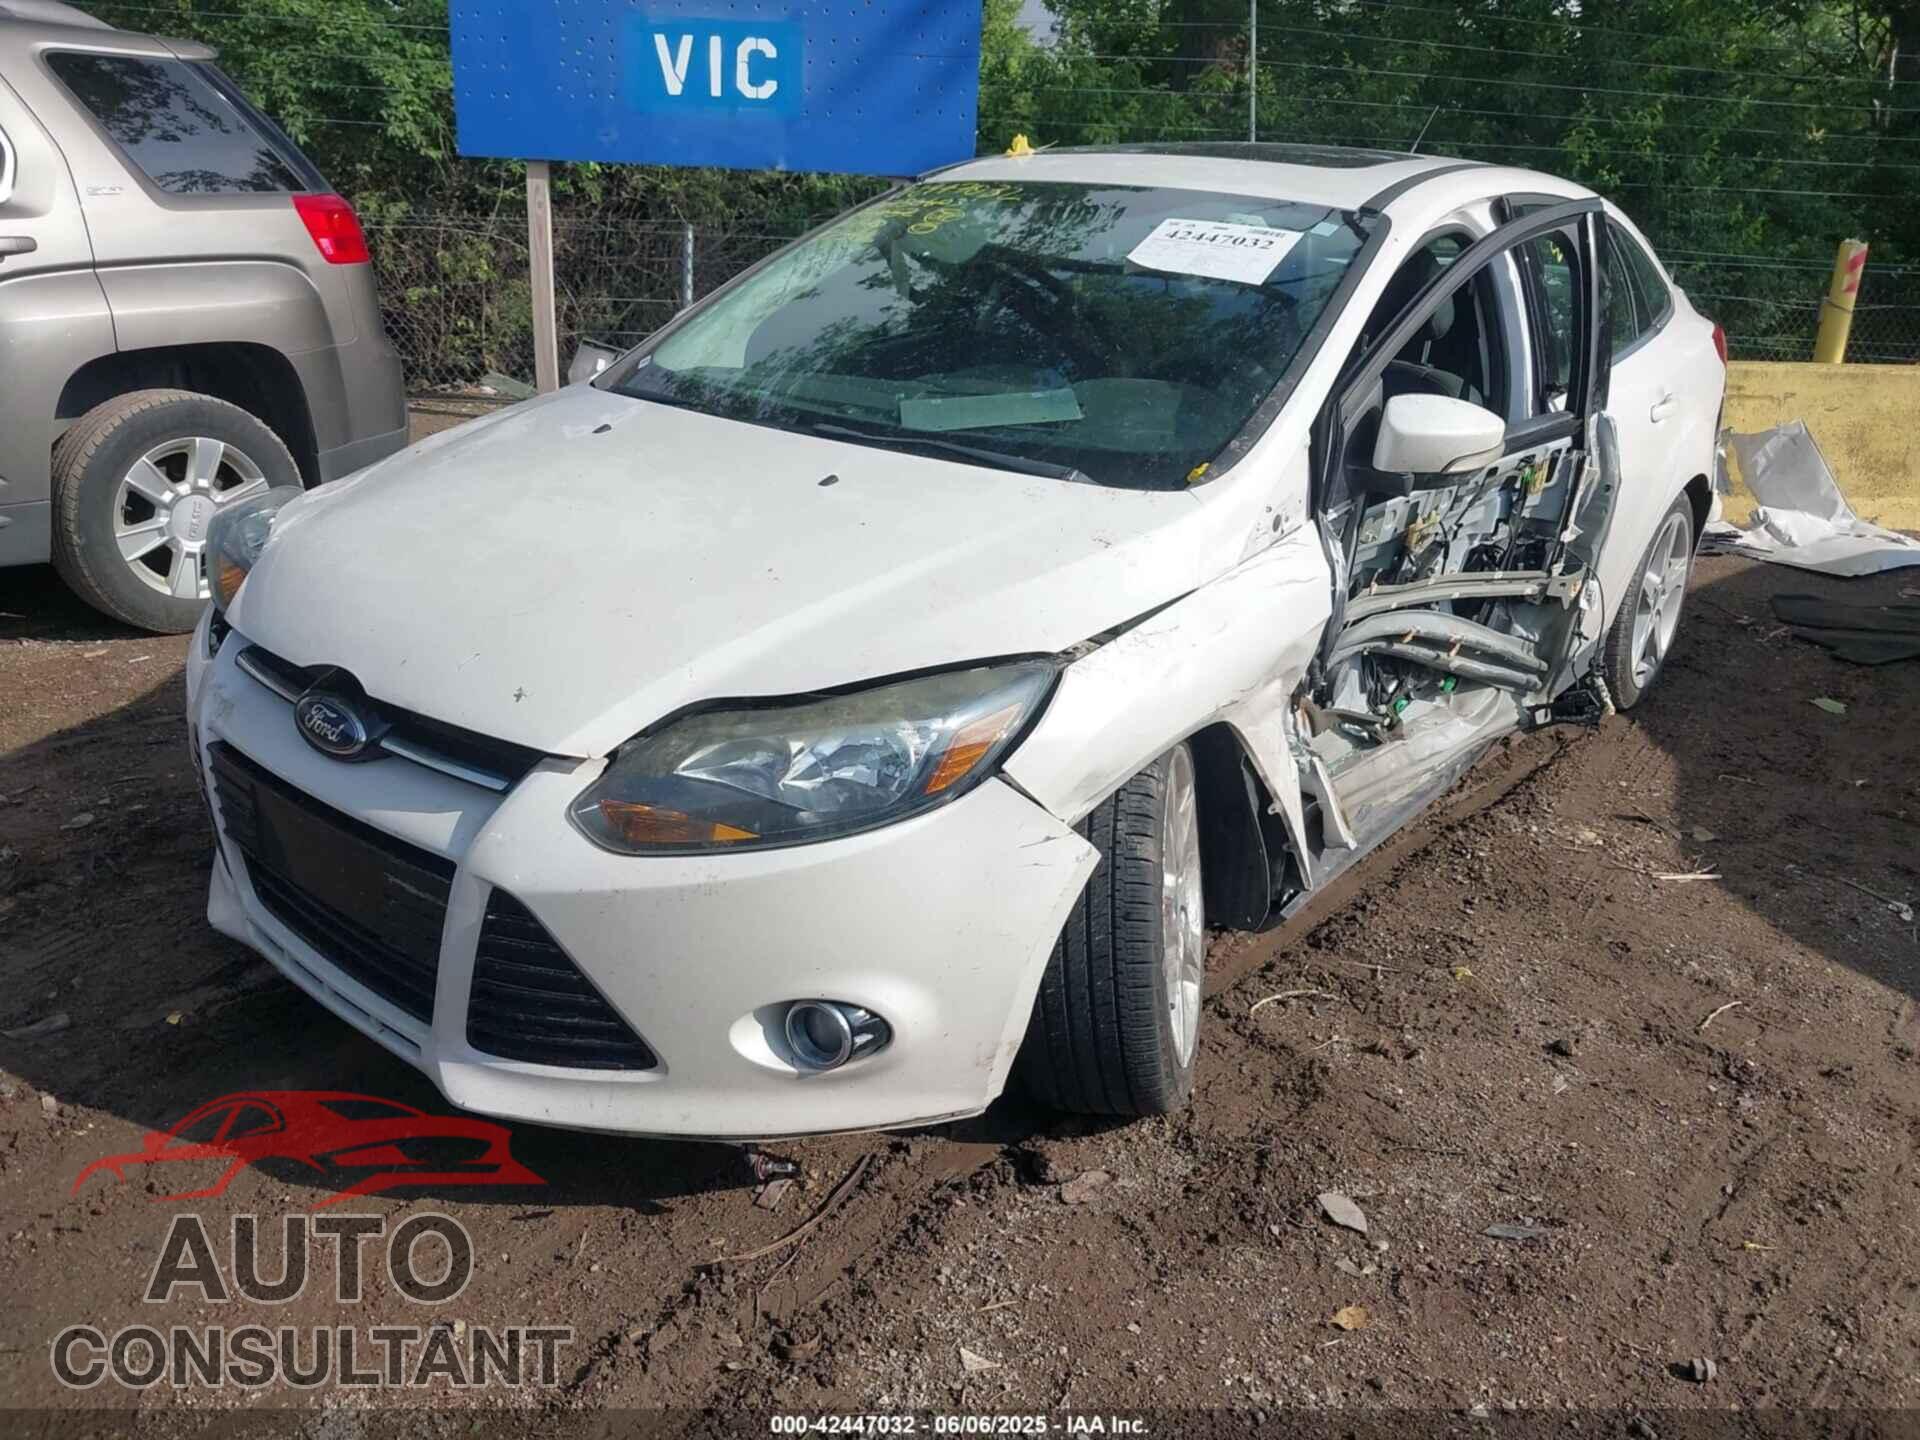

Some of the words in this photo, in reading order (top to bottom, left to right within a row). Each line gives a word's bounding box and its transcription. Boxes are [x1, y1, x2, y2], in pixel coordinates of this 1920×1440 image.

[653, 33, 778, 99] VIC
[1166, 229, 1275, 250] 42447032
[304, 703, 346, 742] Ford
